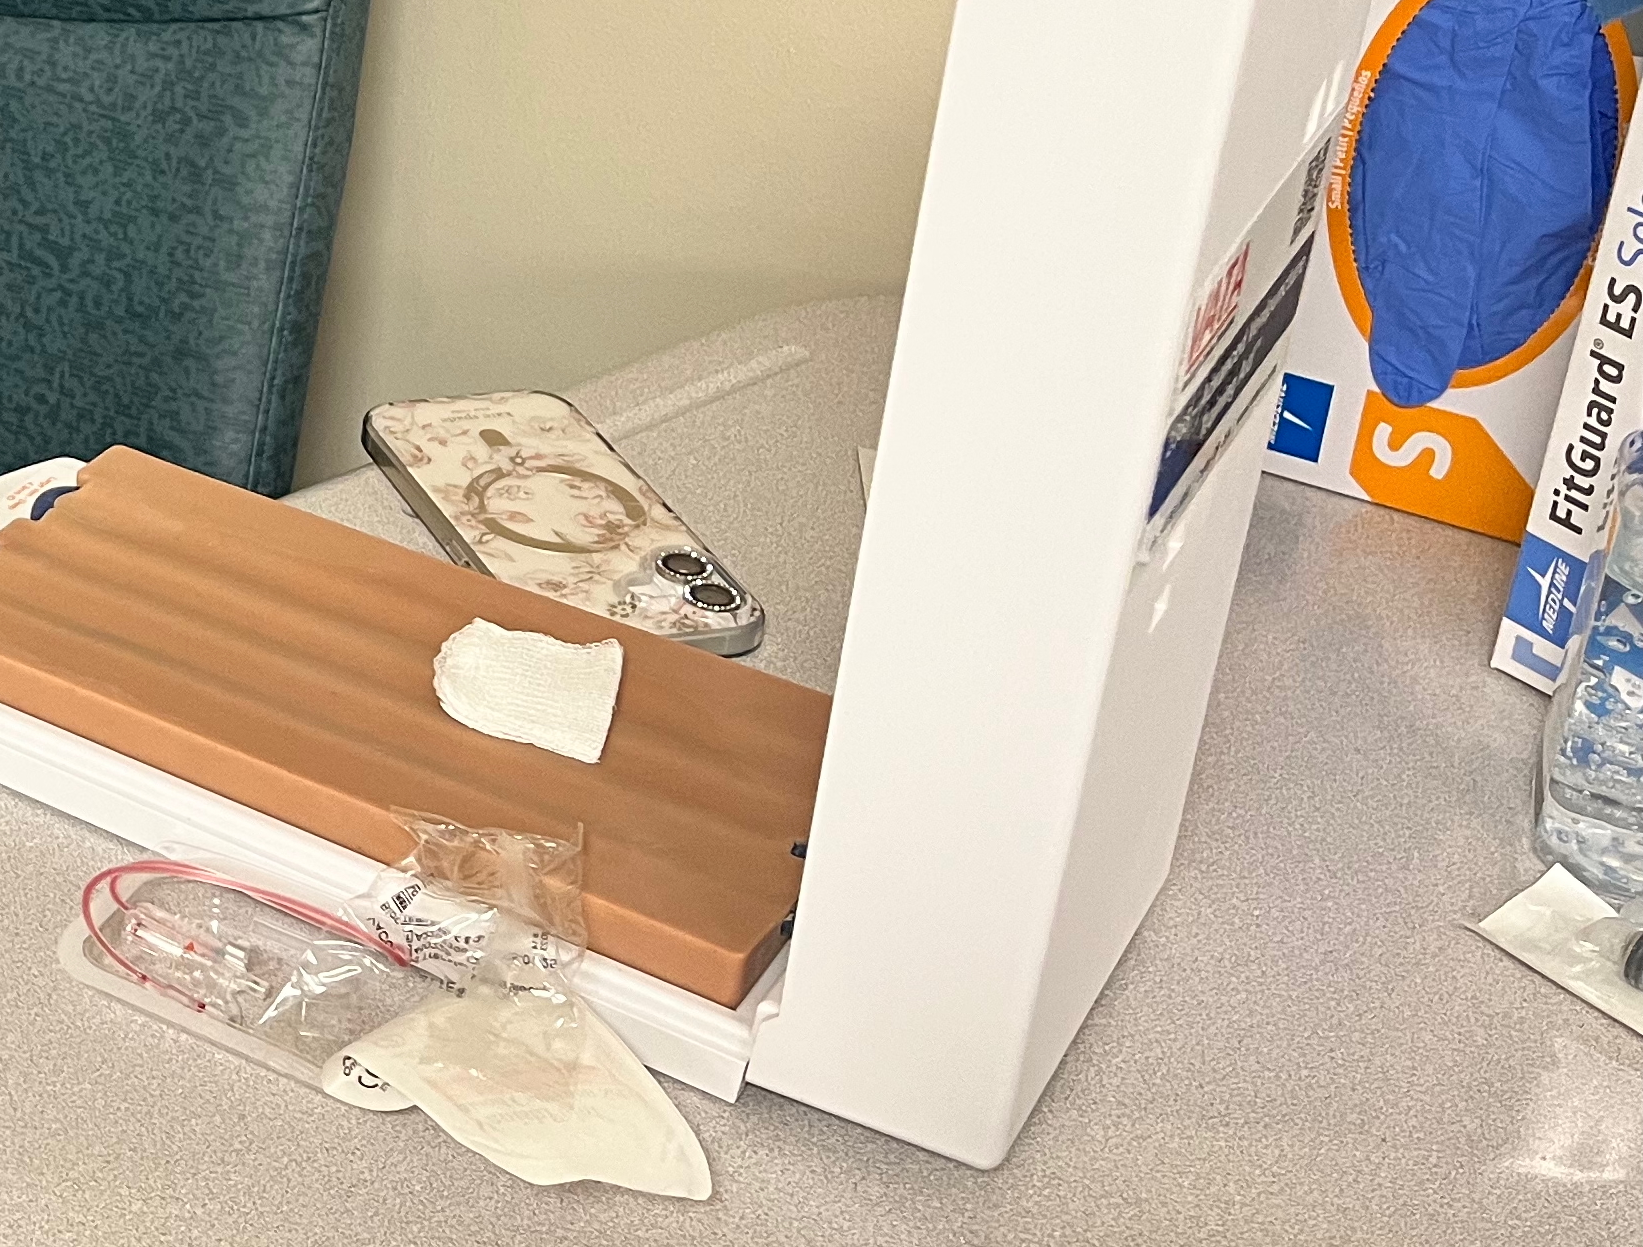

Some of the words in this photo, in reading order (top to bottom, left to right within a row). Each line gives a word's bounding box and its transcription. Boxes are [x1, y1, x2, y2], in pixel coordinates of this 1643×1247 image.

[1599, 276, 1643, 340] ES
[1371, 421, 1452, 481] S
[1541, 557, 1570, 635] MEDLINE
